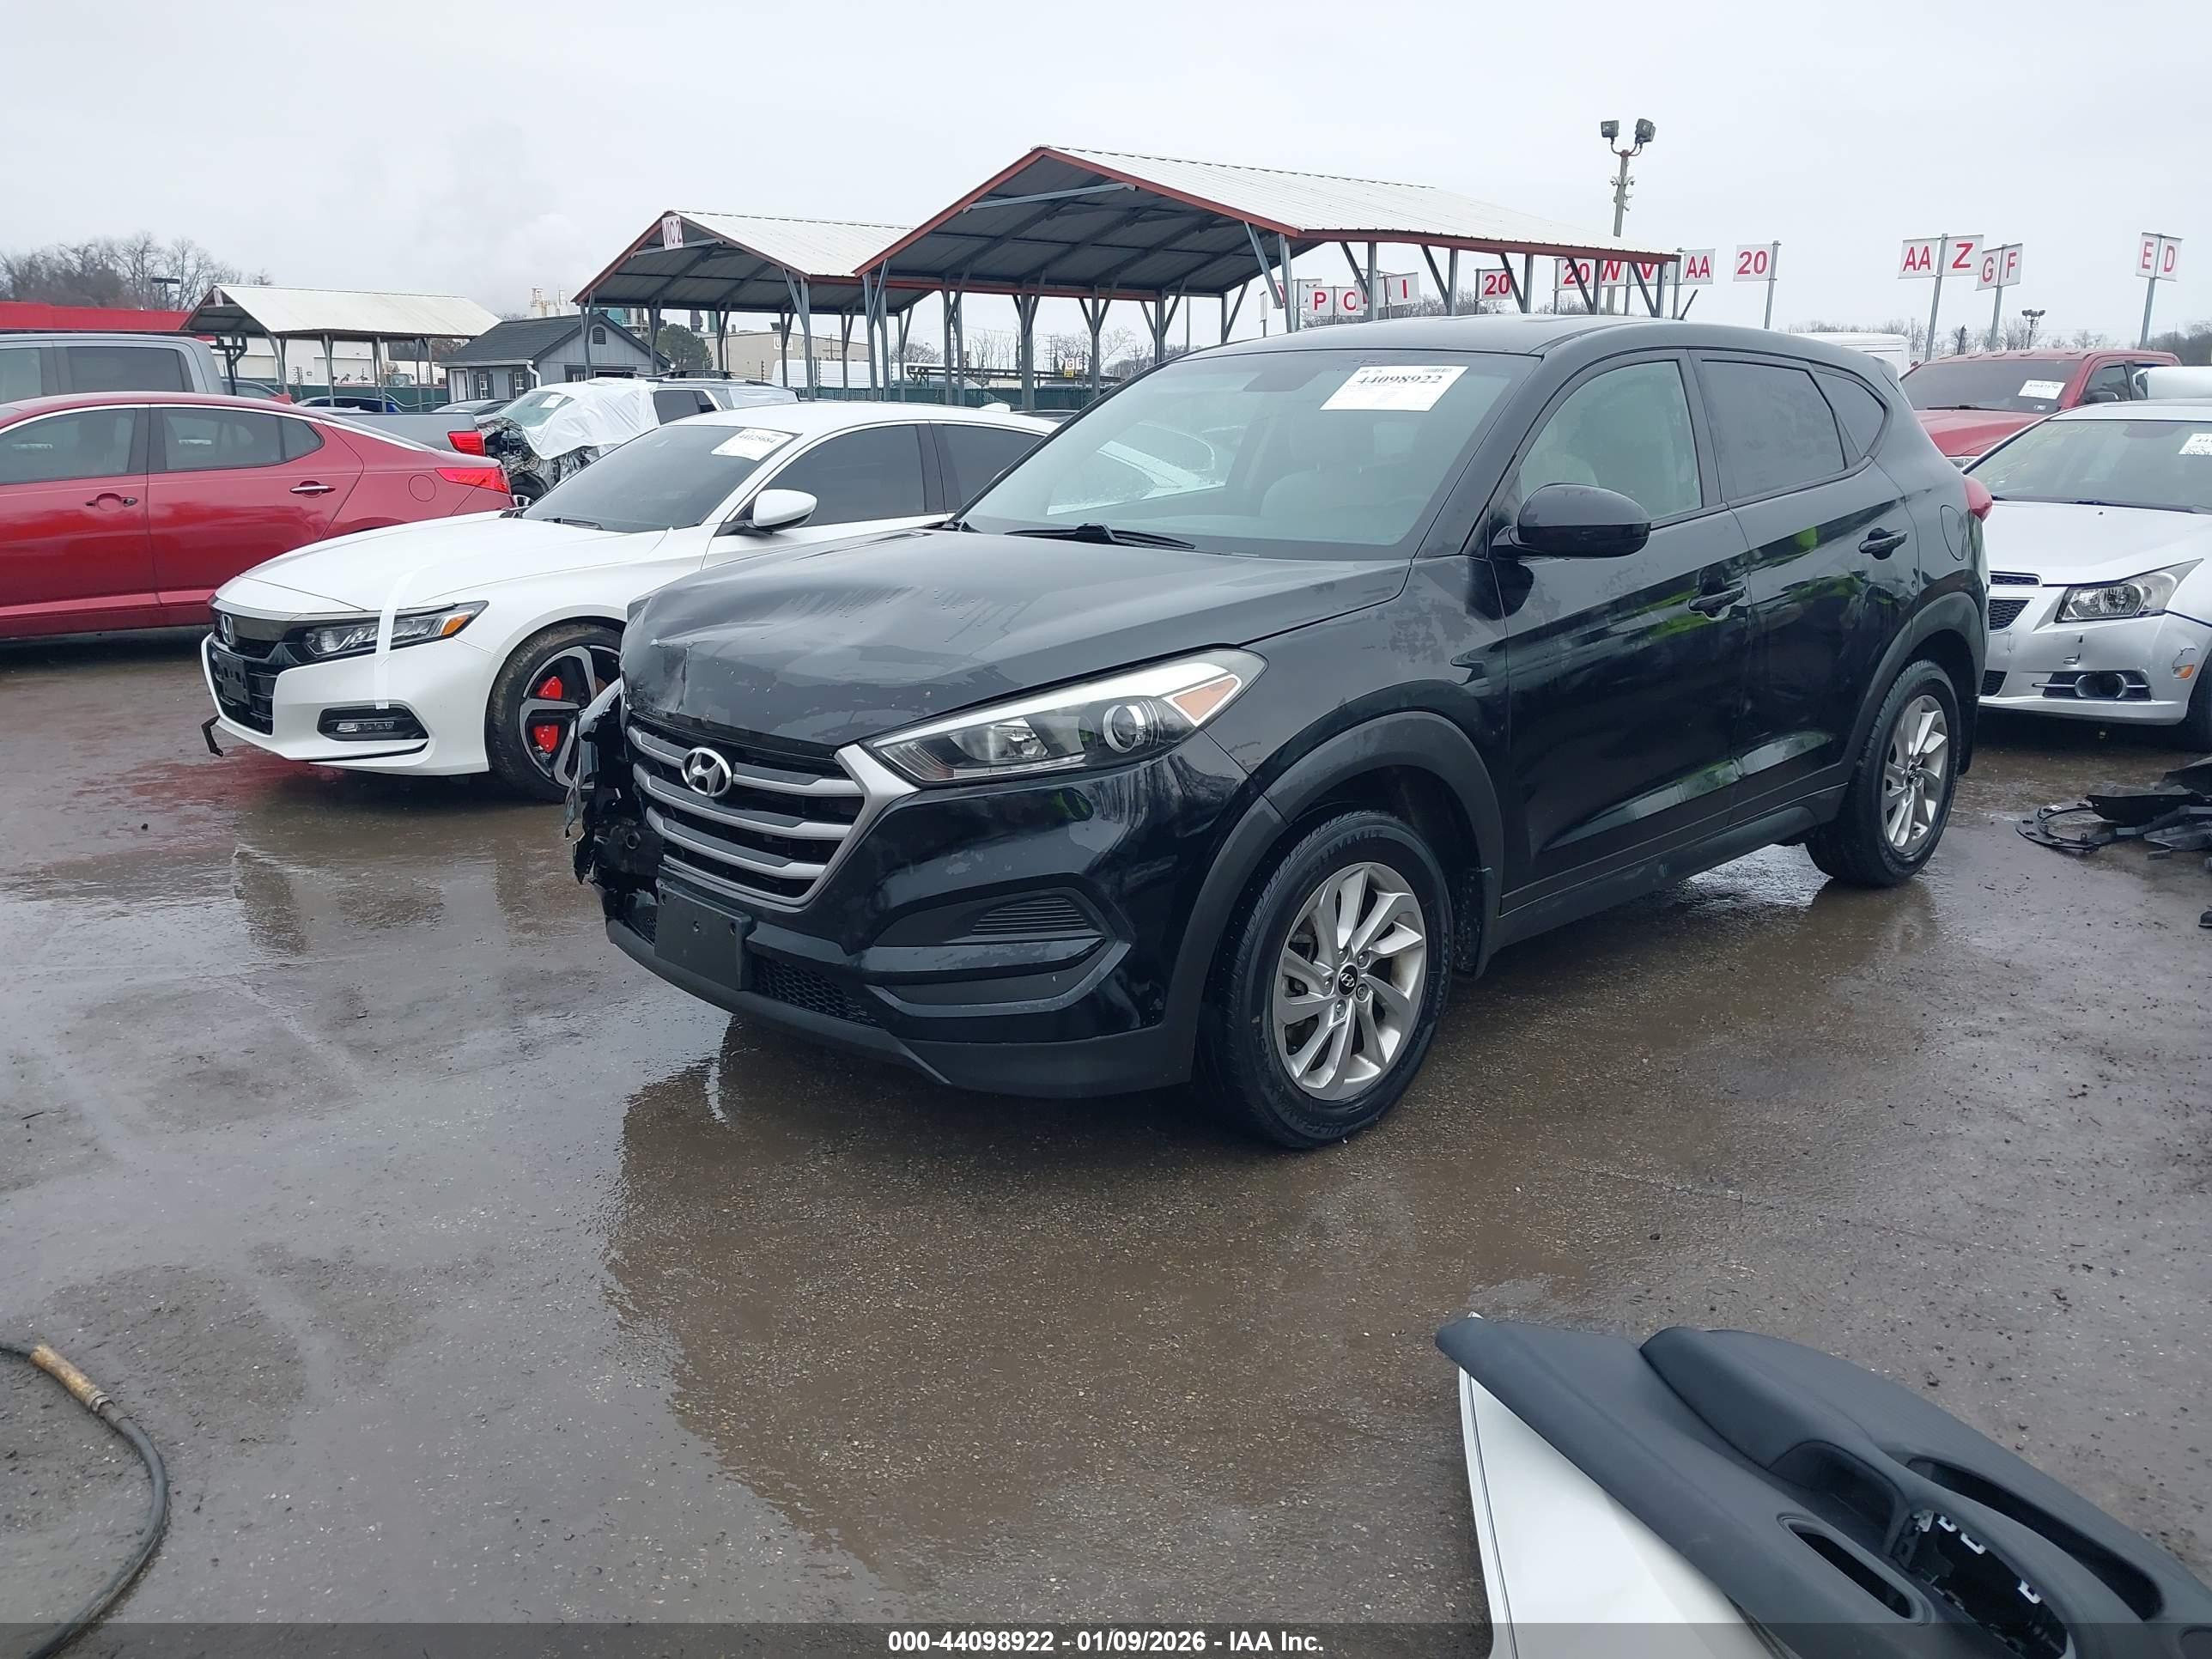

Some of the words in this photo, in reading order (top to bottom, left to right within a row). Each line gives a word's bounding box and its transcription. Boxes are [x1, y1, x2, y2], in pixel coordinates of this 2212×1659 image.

[662, 220, 675, 246] VIC
[675, 219, 682, 243] 2
[1685, 255, 1711, 279] AA
[1737, 250, 1768, 275] 20
[1902, 246, 1931, 272] AA
[1952, 243, 1974, 269] Z
[2006, 252, 2017, 279] F
[2142, 241, 2154, 270] E
[2163, 245, 2176, 272] D
[1563, 262, 1590, 284] 20
[1982, 256, 1995, 283] G
[1484, 274, 1510, 295] 20
[1313, 292, 1327, 311] P
[1066, 359, 1073, 368] G
[1357, 374, 1443, 385] 44098922
